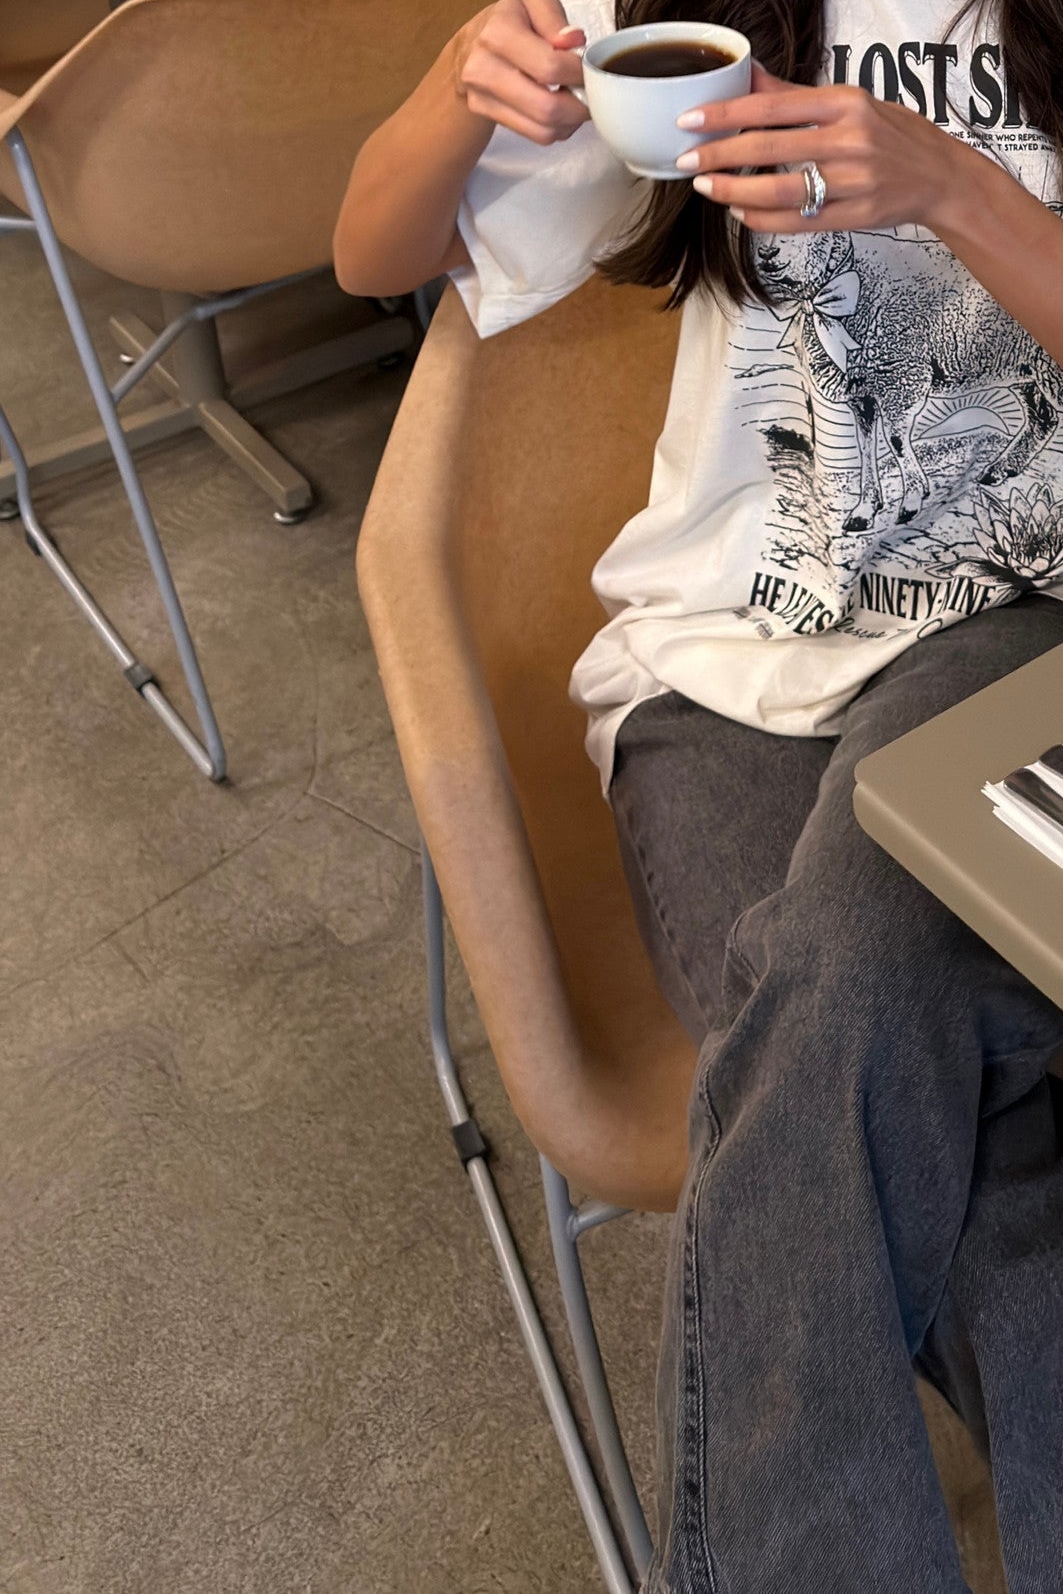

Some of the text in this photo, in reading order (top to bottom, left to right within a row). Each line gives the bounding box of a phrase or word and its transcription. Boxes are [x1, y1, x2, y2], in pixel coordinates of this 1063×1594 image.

[995, 134, 1016, 142] WHO
[1004, 143, 1039, 152] STRAYED
[749, 571, 786, 613] HE
